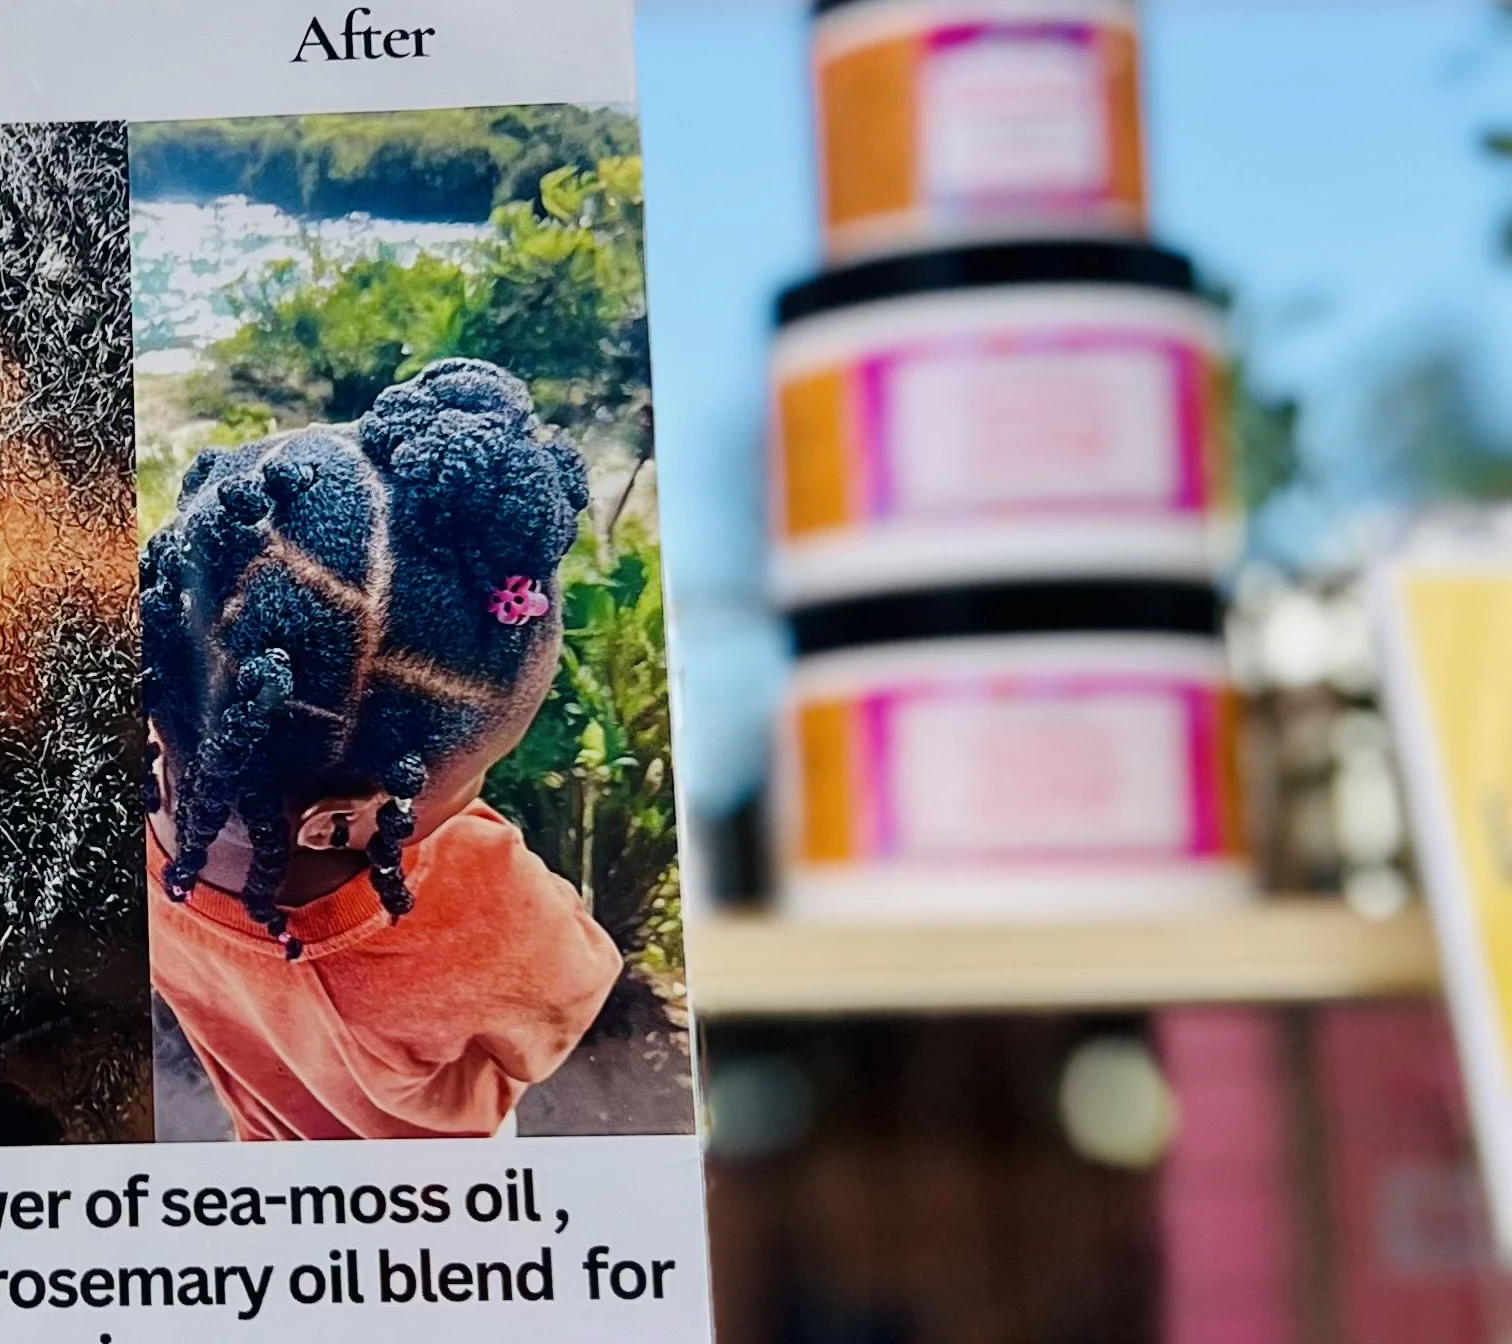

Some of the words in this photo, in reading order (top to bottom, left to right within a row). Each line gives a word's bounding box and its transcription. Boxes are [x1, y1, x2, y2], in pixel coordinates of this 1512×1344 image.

[290, 6, 437, 64] After
[84, 1172, 151, 1230] of
[160, 1183, 452, 1229] sea-moss
[288, 1247, 366, 1306] oil
[377, 1245, 555, 1304] blend
[581, 1244, 677, 1301] for
